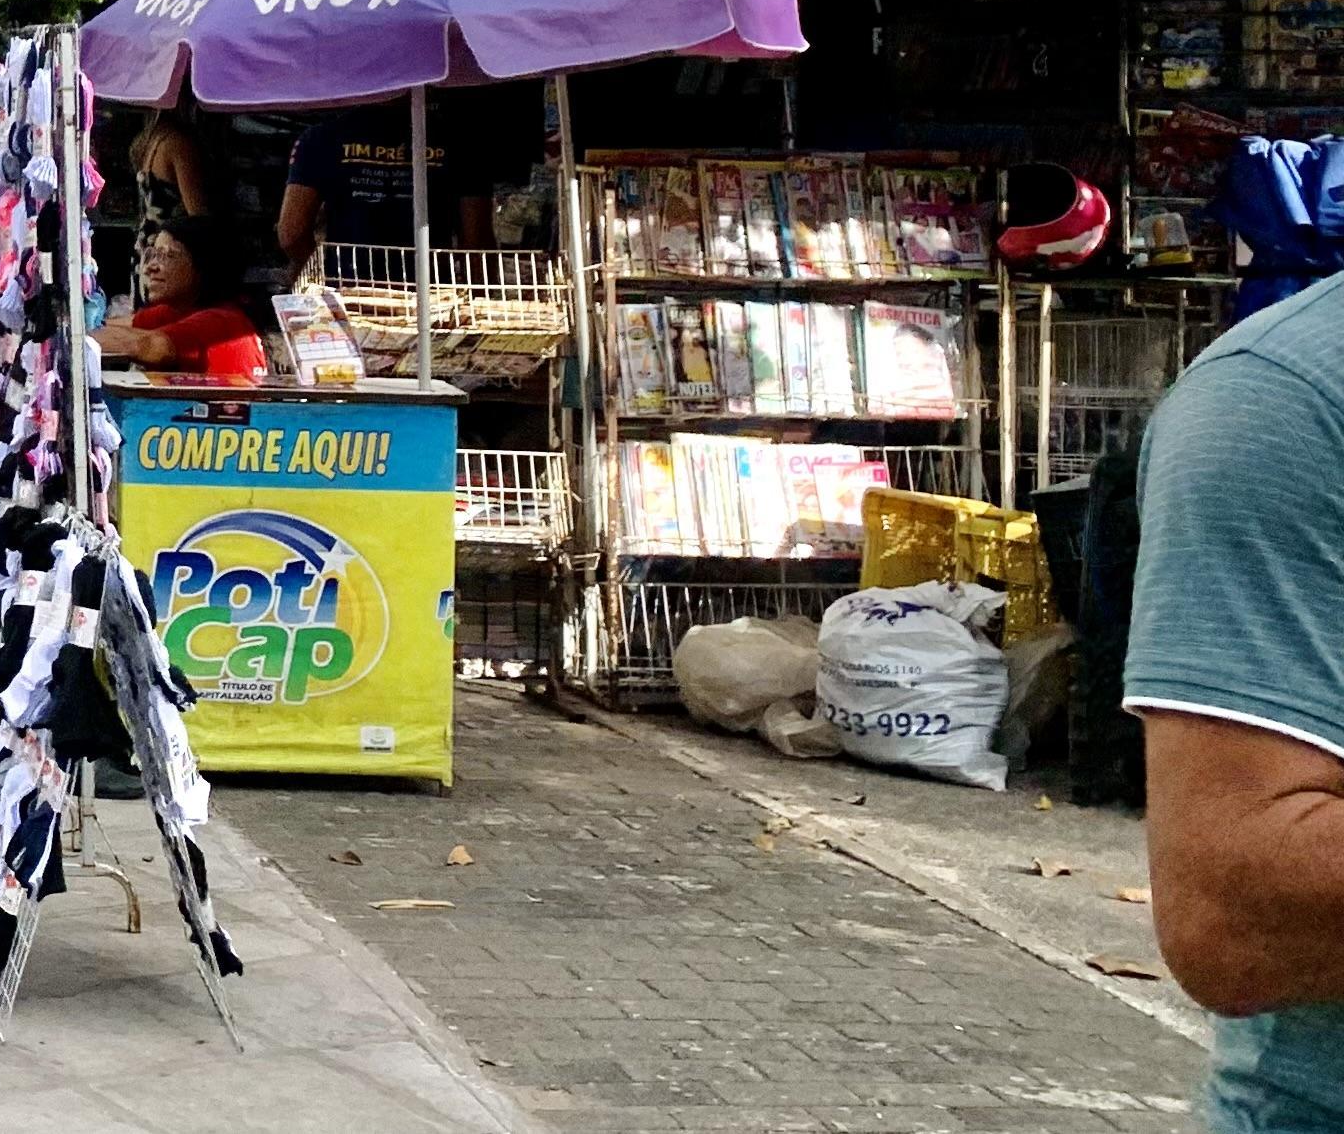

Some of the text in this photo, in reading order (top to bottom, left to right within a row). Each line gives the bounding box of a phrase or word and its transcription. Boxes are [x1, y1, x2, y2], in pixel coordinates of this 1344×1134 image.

[342, 143, 371, 158] TIM
[375, 142, 406, 160] PRÉ
[138, 425, 392, 482] COMPRE AQUI!
[165, 606, 354, 703] Cap
[221, 682, 258, 690] TÍTULO
[196, 691, 273, 702] APITALIZAÇÃO
